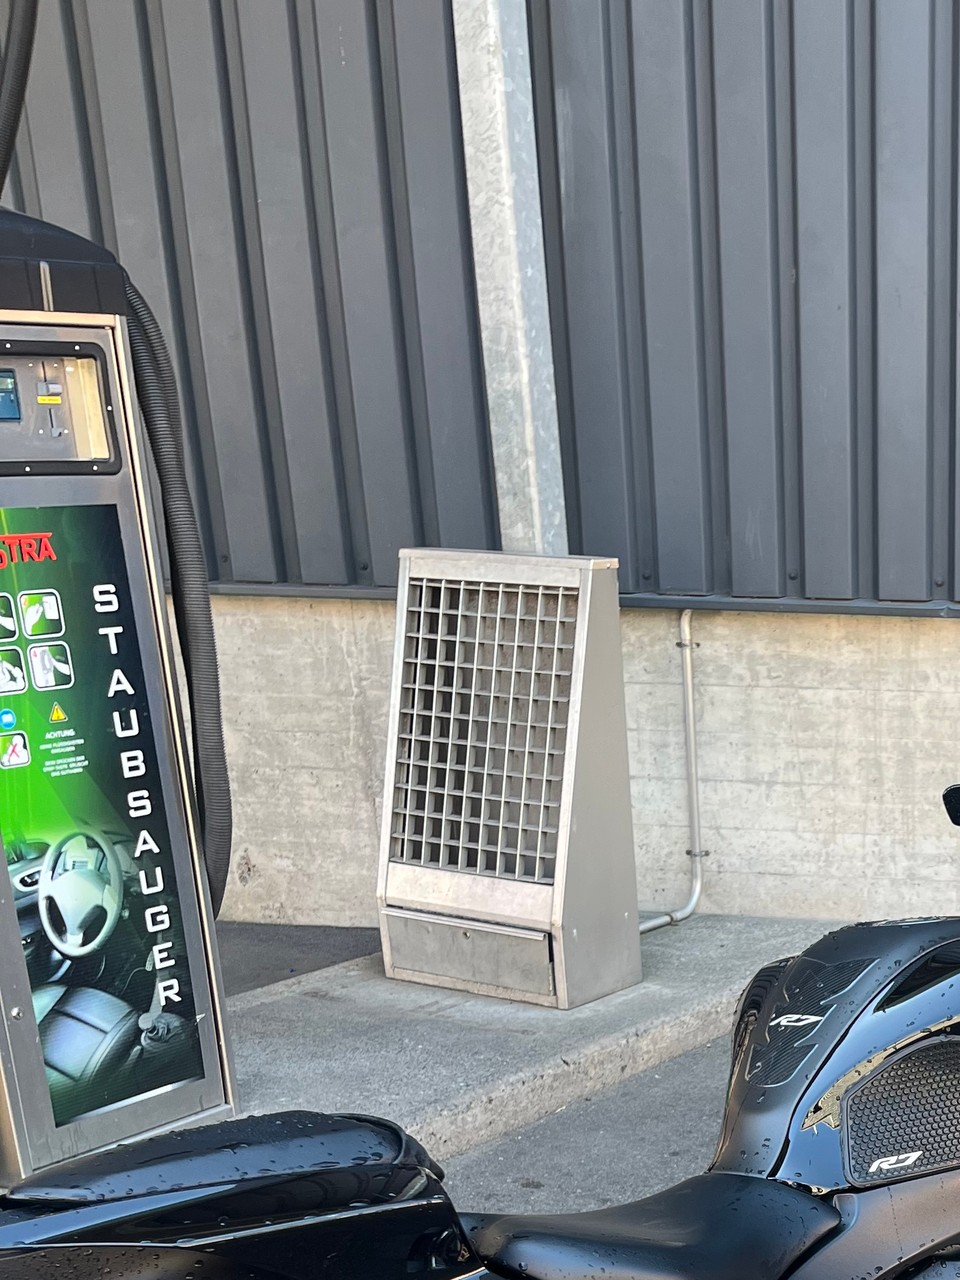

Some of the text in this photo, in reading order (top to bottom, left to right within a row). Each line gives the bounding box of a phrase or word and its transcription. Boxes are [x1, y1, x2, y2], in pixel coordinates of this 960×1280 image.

[92, 583, 182, 1006] STAUBSAUGER
[769, 1013, 824, 1026] R7
[868, 1150, 923, 1173] R7
